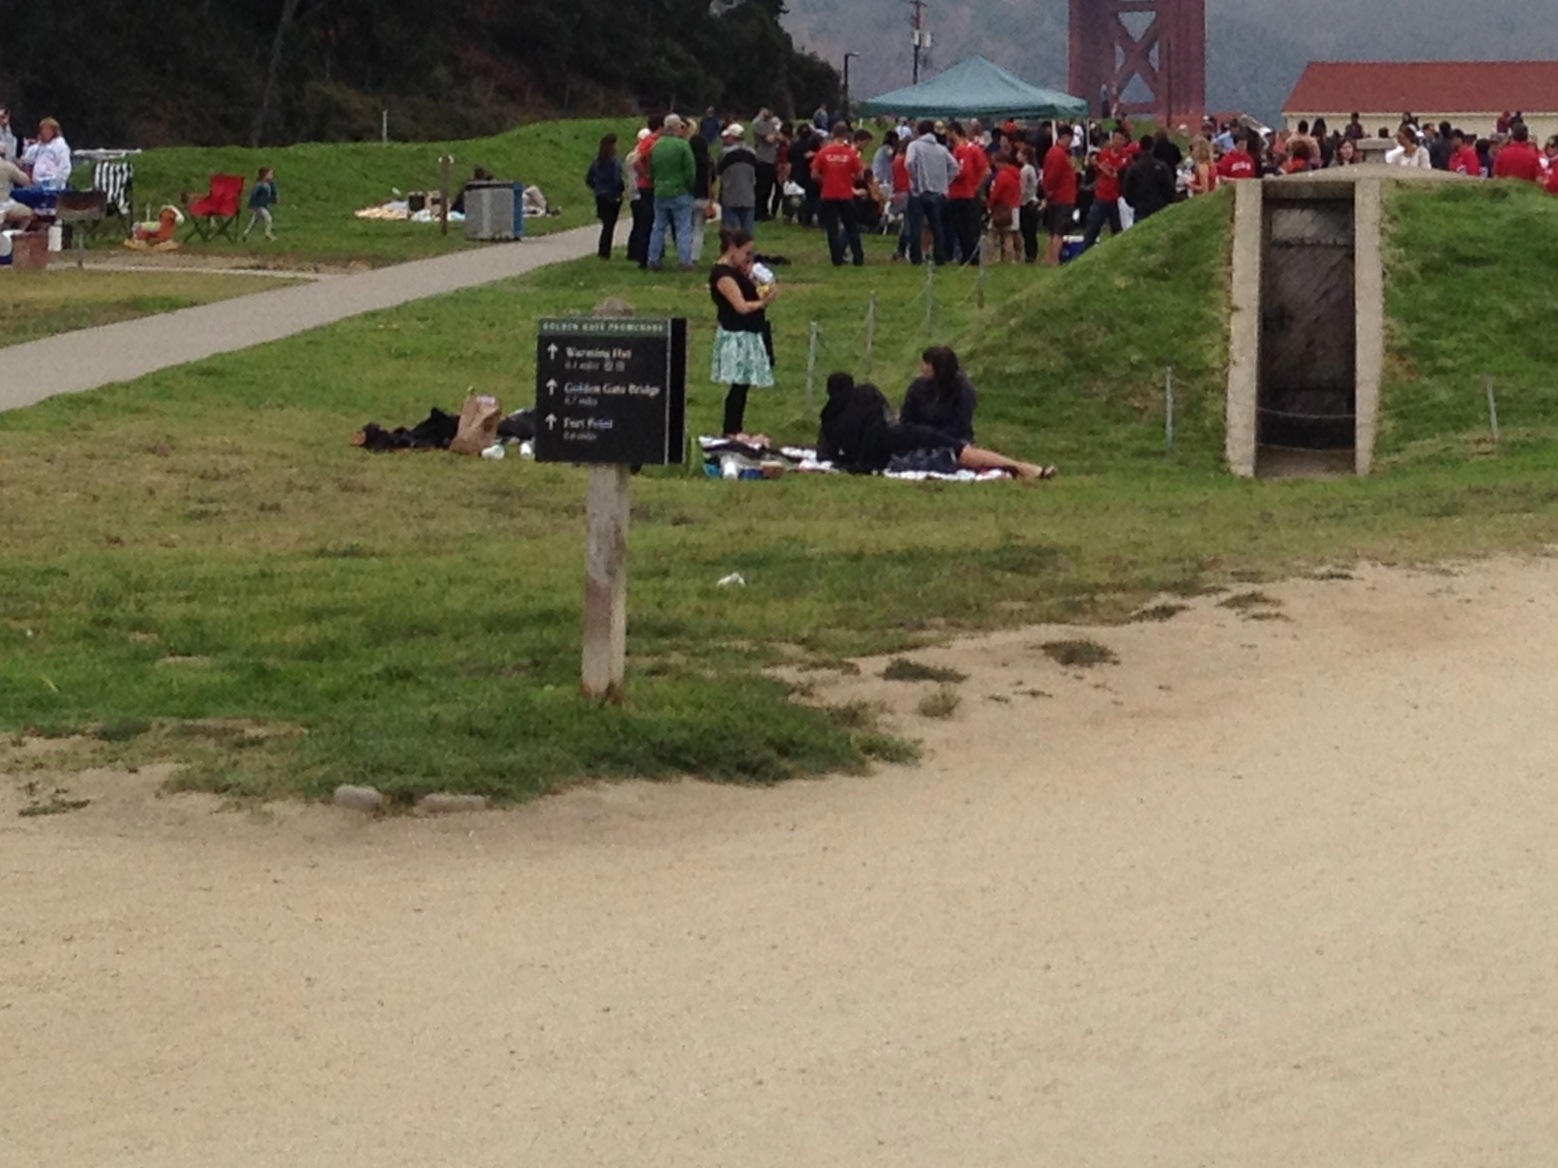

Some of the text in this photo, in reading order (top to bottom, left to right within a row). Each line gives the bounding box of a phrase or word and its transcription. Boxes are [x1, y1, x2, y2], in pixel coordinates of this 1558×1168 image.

[582, 322, 605, 332] GATE
[566, 346, 632, 359] Warming Hut
[564, 382, 660, 397] Golden Gate Bridge
[563, 417, 614, 429] Fort Point
